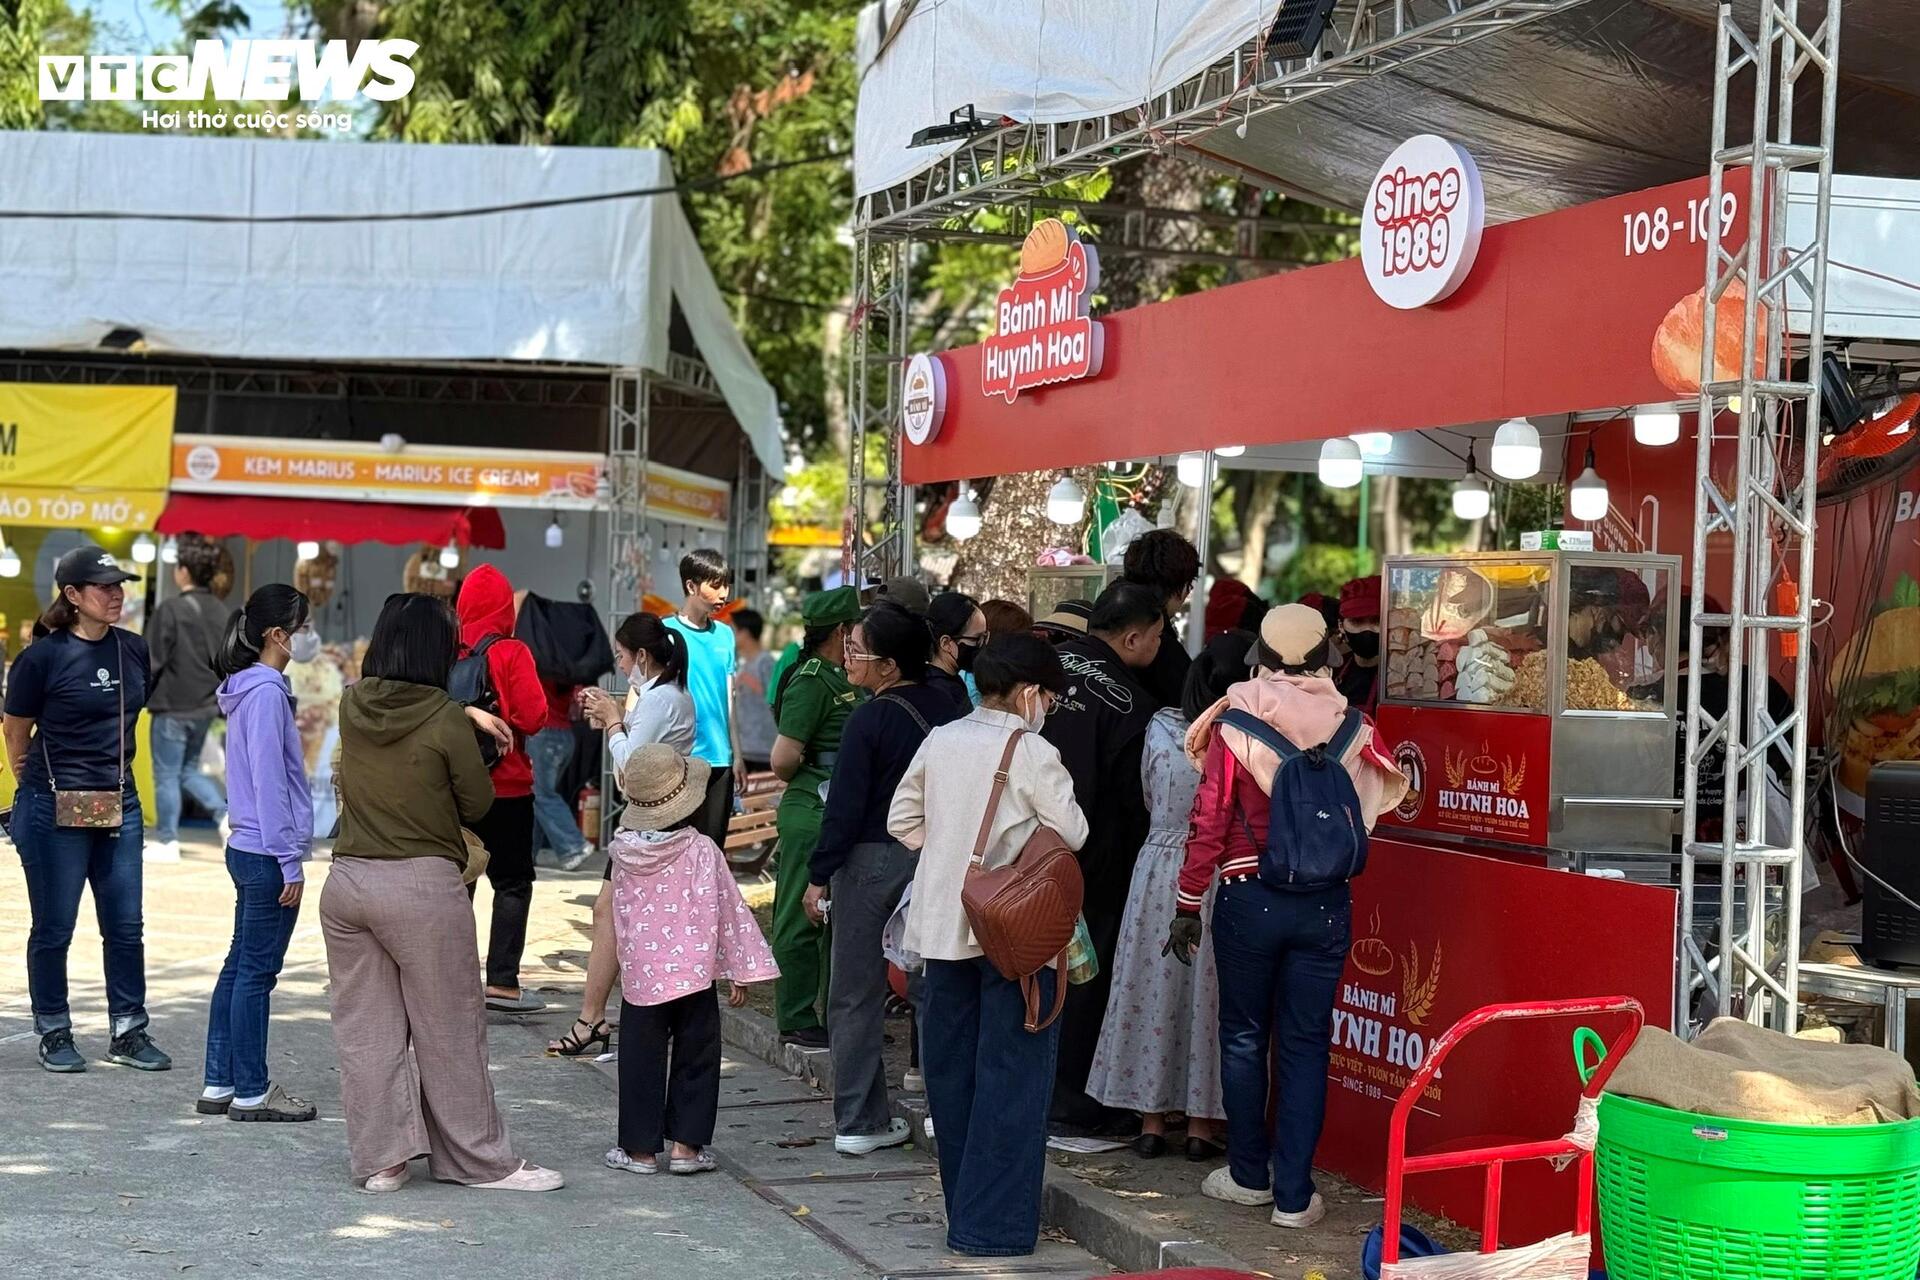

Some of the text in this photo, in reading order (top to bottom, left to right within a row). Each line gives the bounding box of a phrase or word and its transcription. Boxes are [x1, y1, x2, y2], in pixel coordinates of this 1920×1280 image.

[1374, 166, 1460, 226] Since
[1382, 213, 1449, 277] 1989
[999, 291, 1046, 337] Bánh
[985, 330, 1085, 390] Huynh Hoa
[244, 457, 283, 475] KEM
[288, 458, 355, 479] MARIUS
[375, 463, 442, 483] MARIUS
[448, 467, 474, 484] ICE
[478, 469, 540, 488] CREAM
[1438, 790, 1530, 819] HUYNH HOA
[1466, 778, 1500, 793] BÁNH MÌ
[1342, 981, 1397, 1017] BÁNH MÌ
[1331, 1008, 1382, 1058] YNH
[1342, 1075, 1382, 1100] SINCE 1989
